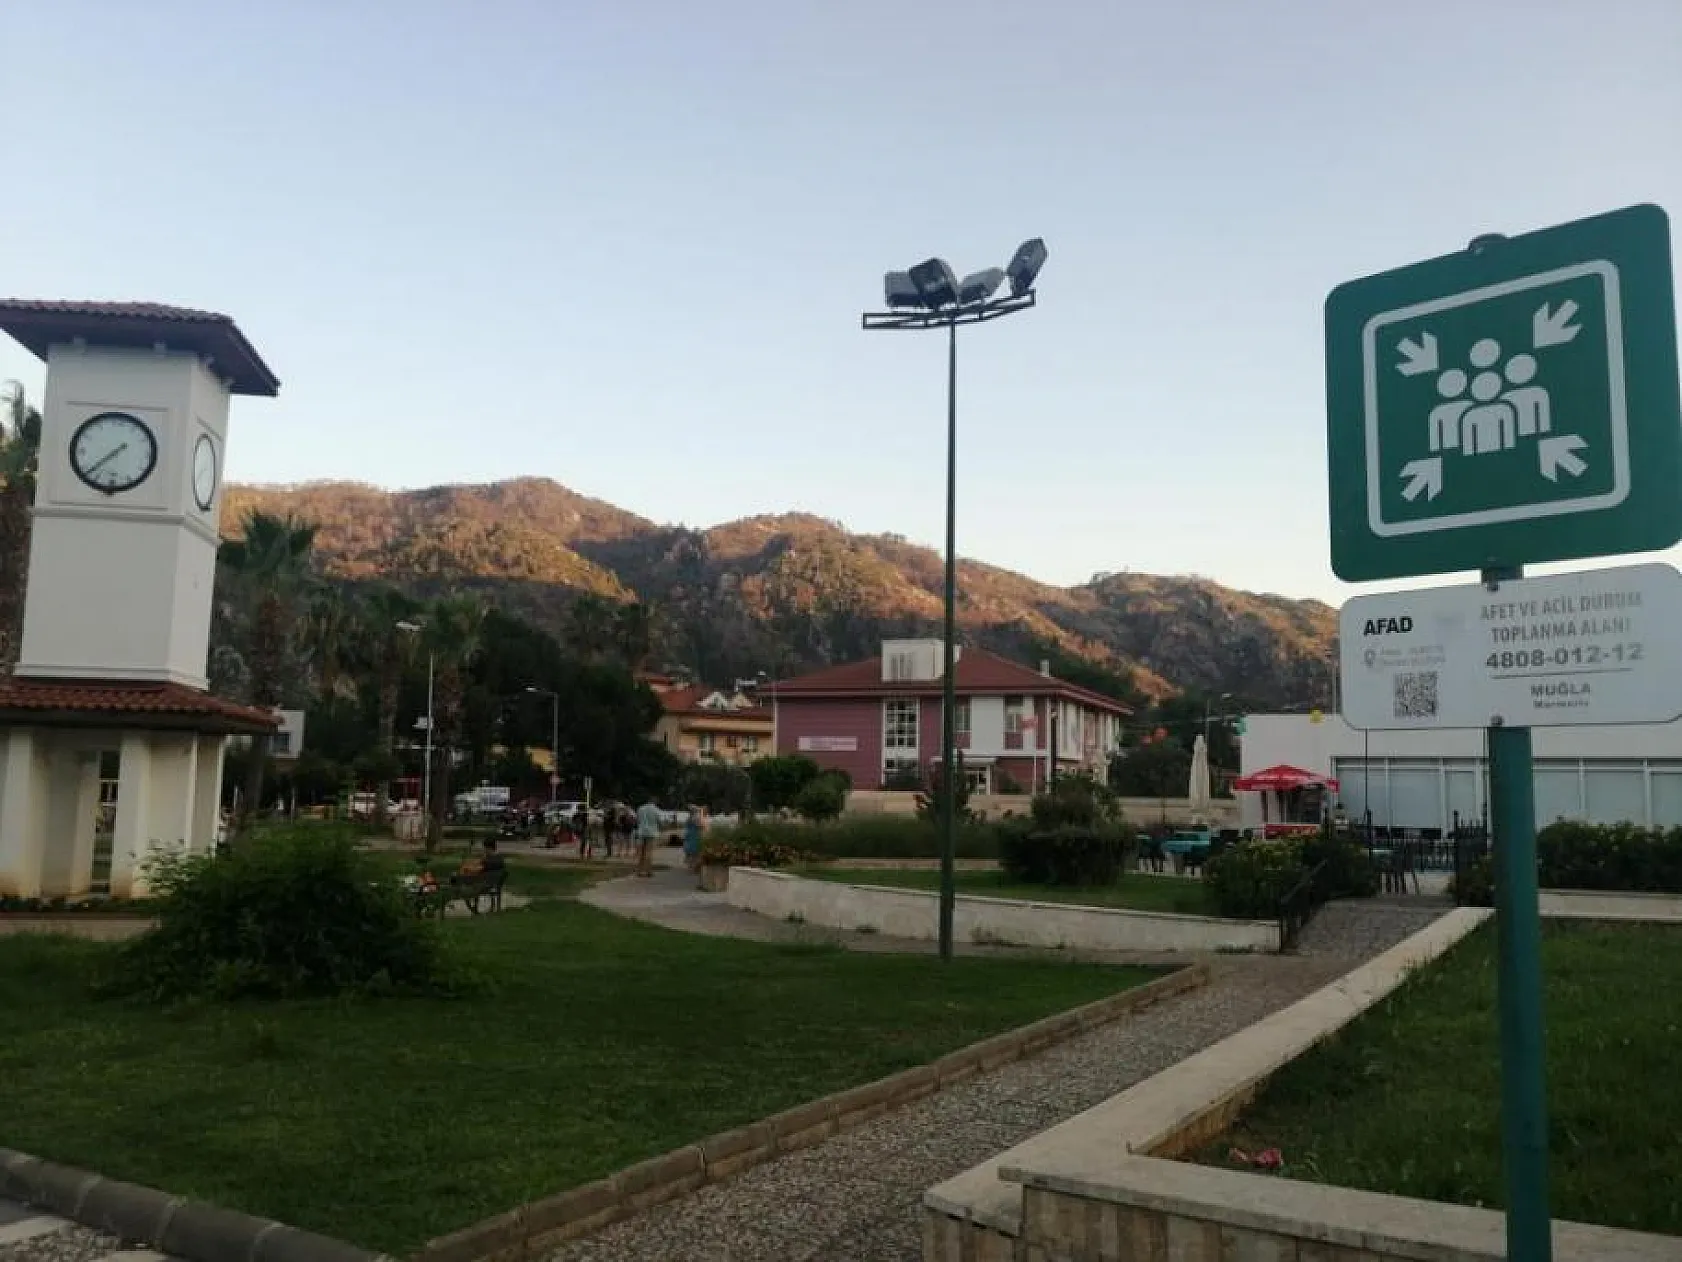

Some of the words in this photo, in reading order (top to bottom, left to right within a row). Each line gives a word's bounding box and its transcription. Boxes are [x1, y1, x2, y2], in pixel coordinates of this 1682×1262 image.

[1480, 602, 1516, 620] AFET
[1519, 600, 1538, 617] VE
[1363, 616, 1414, 636] AFAD
[1486, 642, 1644, 669] 4808-012-12
